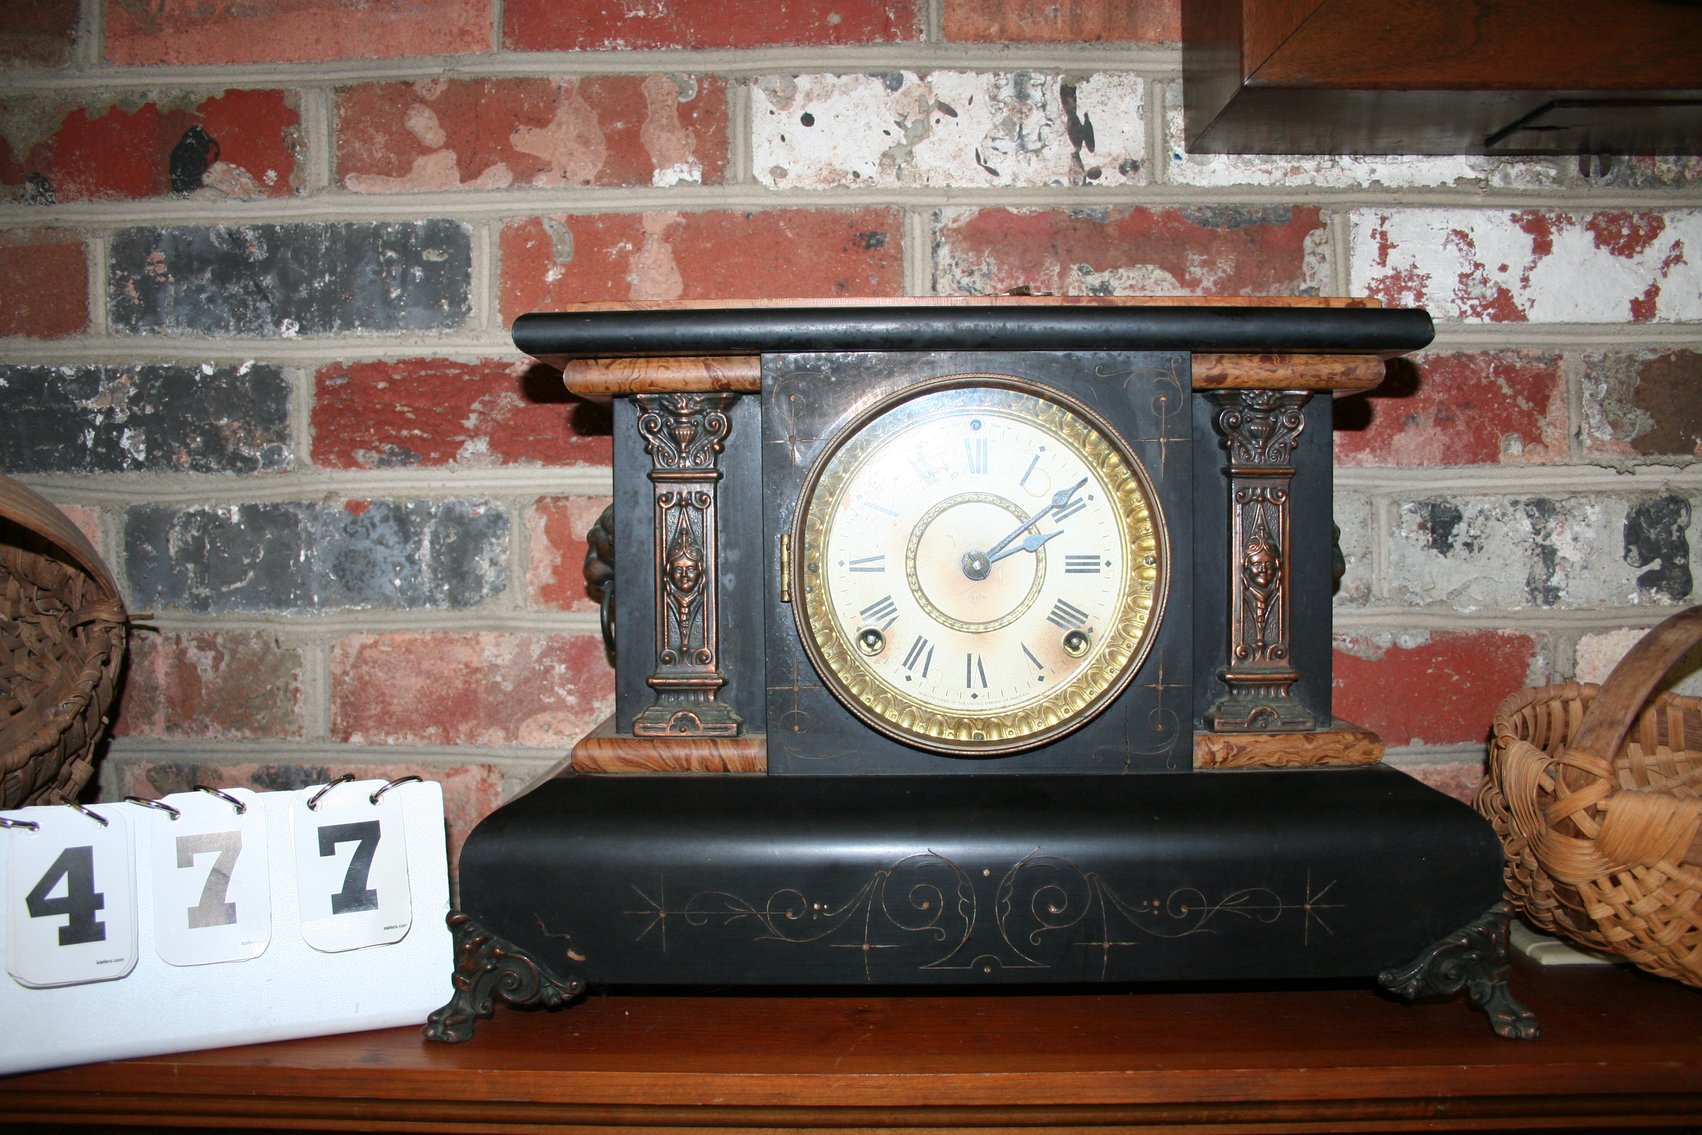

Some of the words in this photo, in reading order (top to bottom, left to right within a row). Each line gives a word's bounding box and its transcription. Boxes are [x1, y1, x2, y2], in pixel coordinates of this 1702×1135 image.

[1019, 454, 1040, 487] I
[1051, 497, 1087, 524] II
[1065, 555, 1101, 574] III
[25, 845, 106, 946] 4
[176, 830, 242, 929] 7
[317, 820, 381, 915] 7
